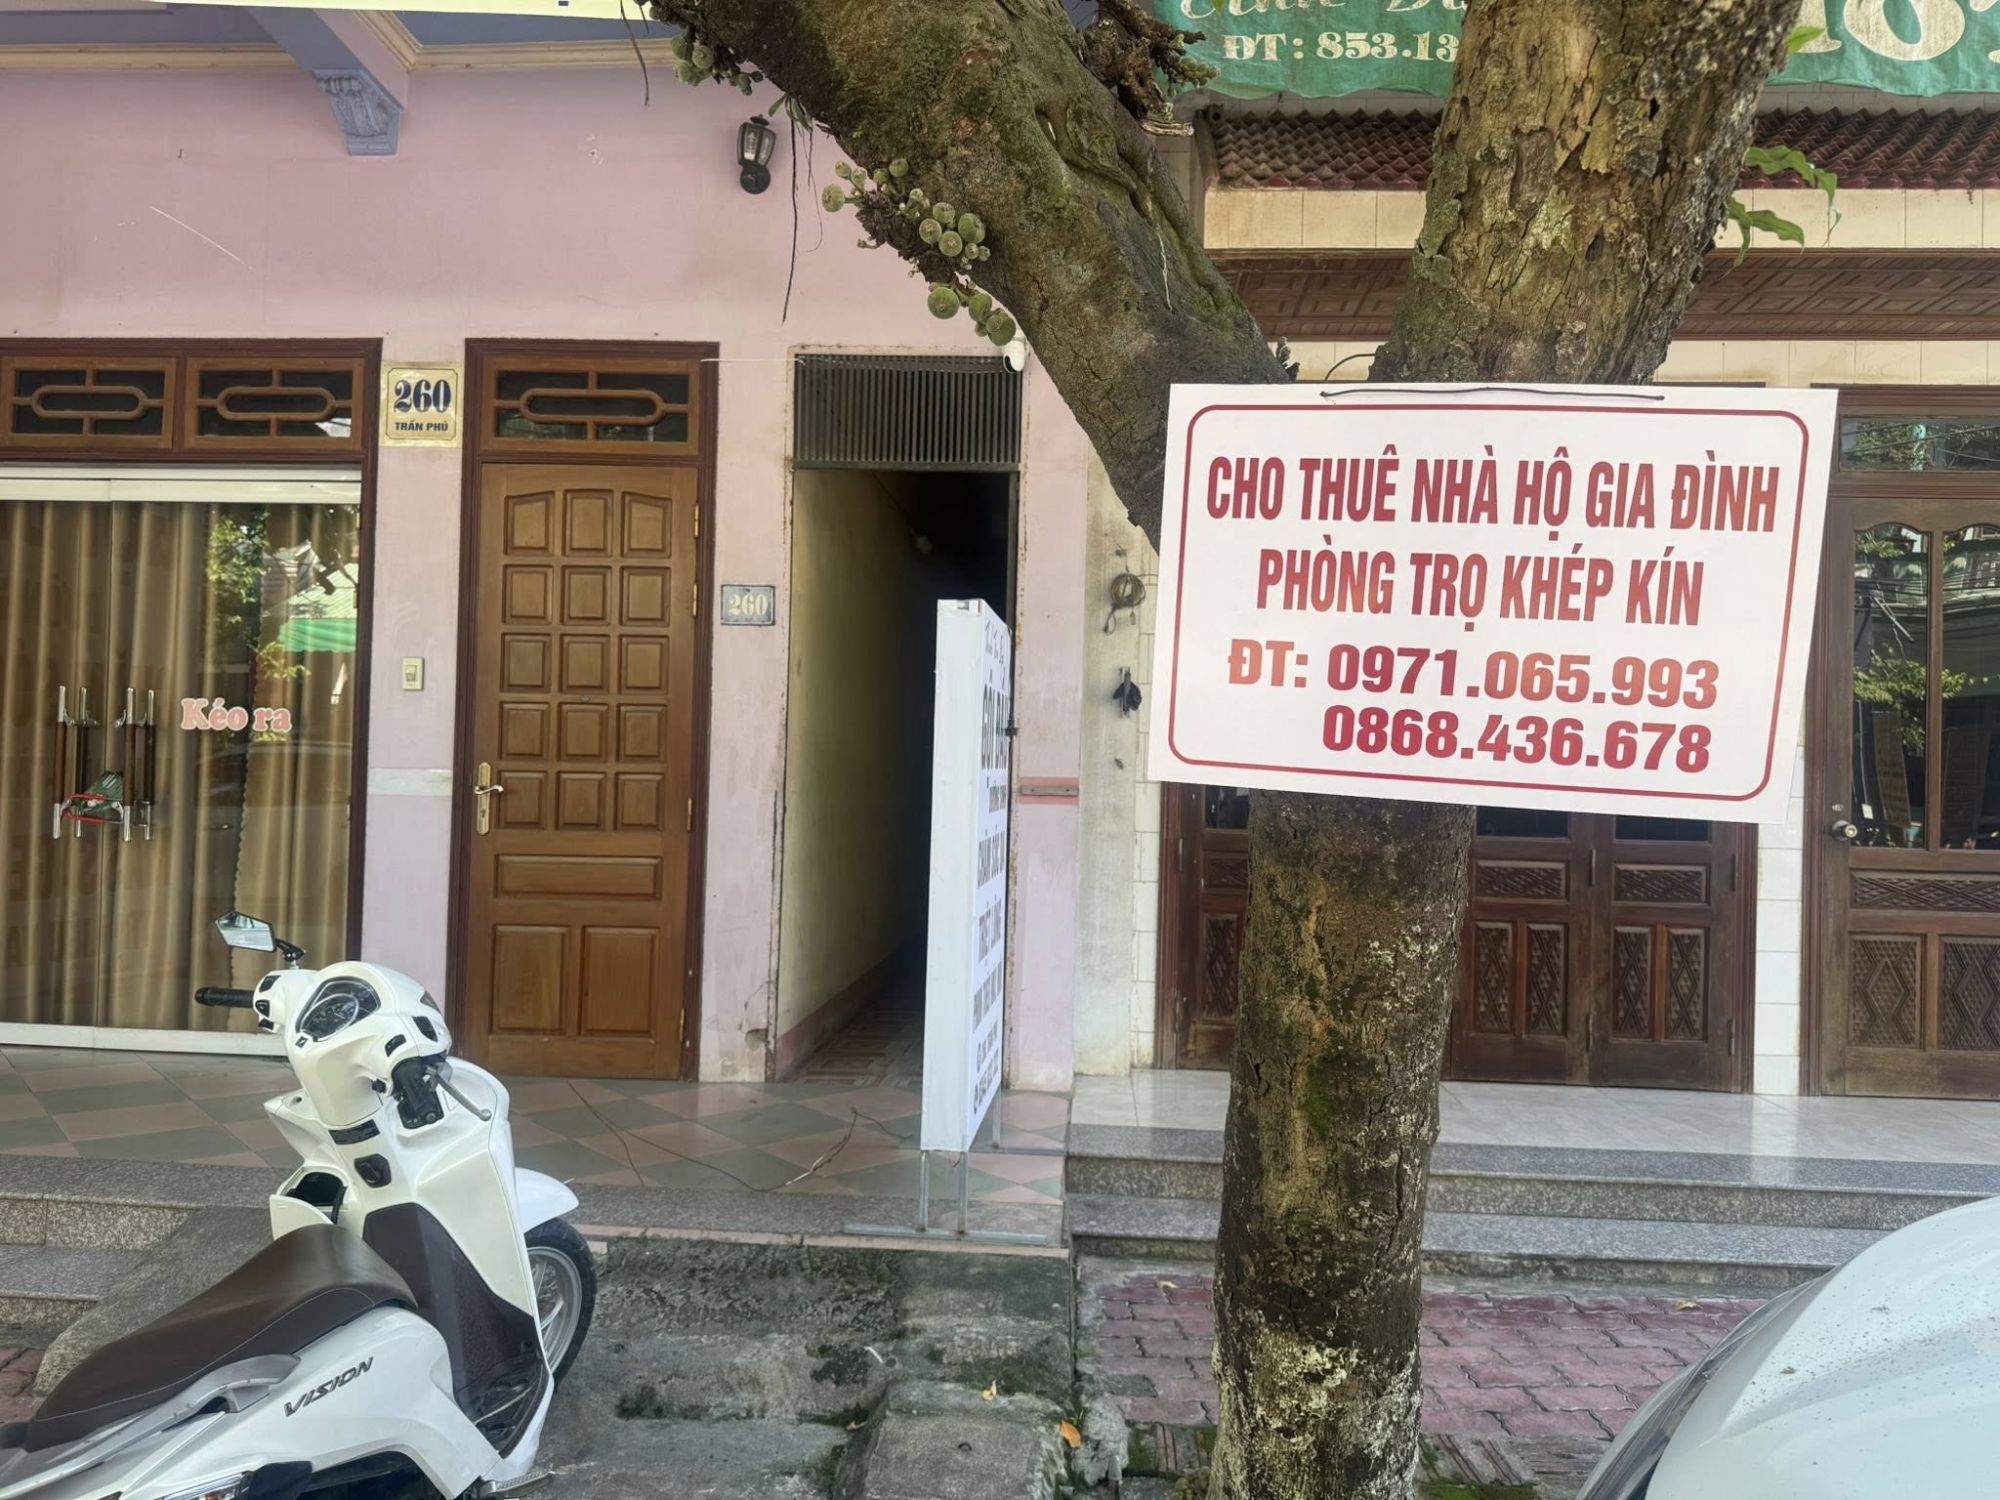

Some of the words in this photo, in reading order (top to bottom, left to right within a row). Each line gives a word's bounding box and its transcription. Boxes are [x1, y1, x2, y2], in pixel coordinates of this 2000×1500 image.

[1223, 32, 1304, 62] ĐT:
[394, 379, 451, 413] 260
[1206, 456, 1285, 520] CHO
[1300, 444, 1399, 523] THUÊ
[1411, 444, 1498, 524] NHÀ
[1513, 446, 1573, 541] HỘ
[1585, 462, 1655, 528] GIA
[1671, 450, 1780, 532] ĐÌNH
[729, 593, 768, 616] 260
[1257, 534, 1396, 614] PHÒNG
[1410, 552, 1488, 632] TRỌ
[1500, 542, 1614, 621] KHÉP
[1626, 545, 1704, 626] KÍN
[1227, 638, 1308, 689] ĐT:
[1327, 644, 1719, 710] 0971.065.993
[181, 697, 249, 731] Kéo
[253, 707, 292, 732] ra
[1322, 705, 1712, 774] 0868.436.678
[284, 1356, 374, 1417] VISION
